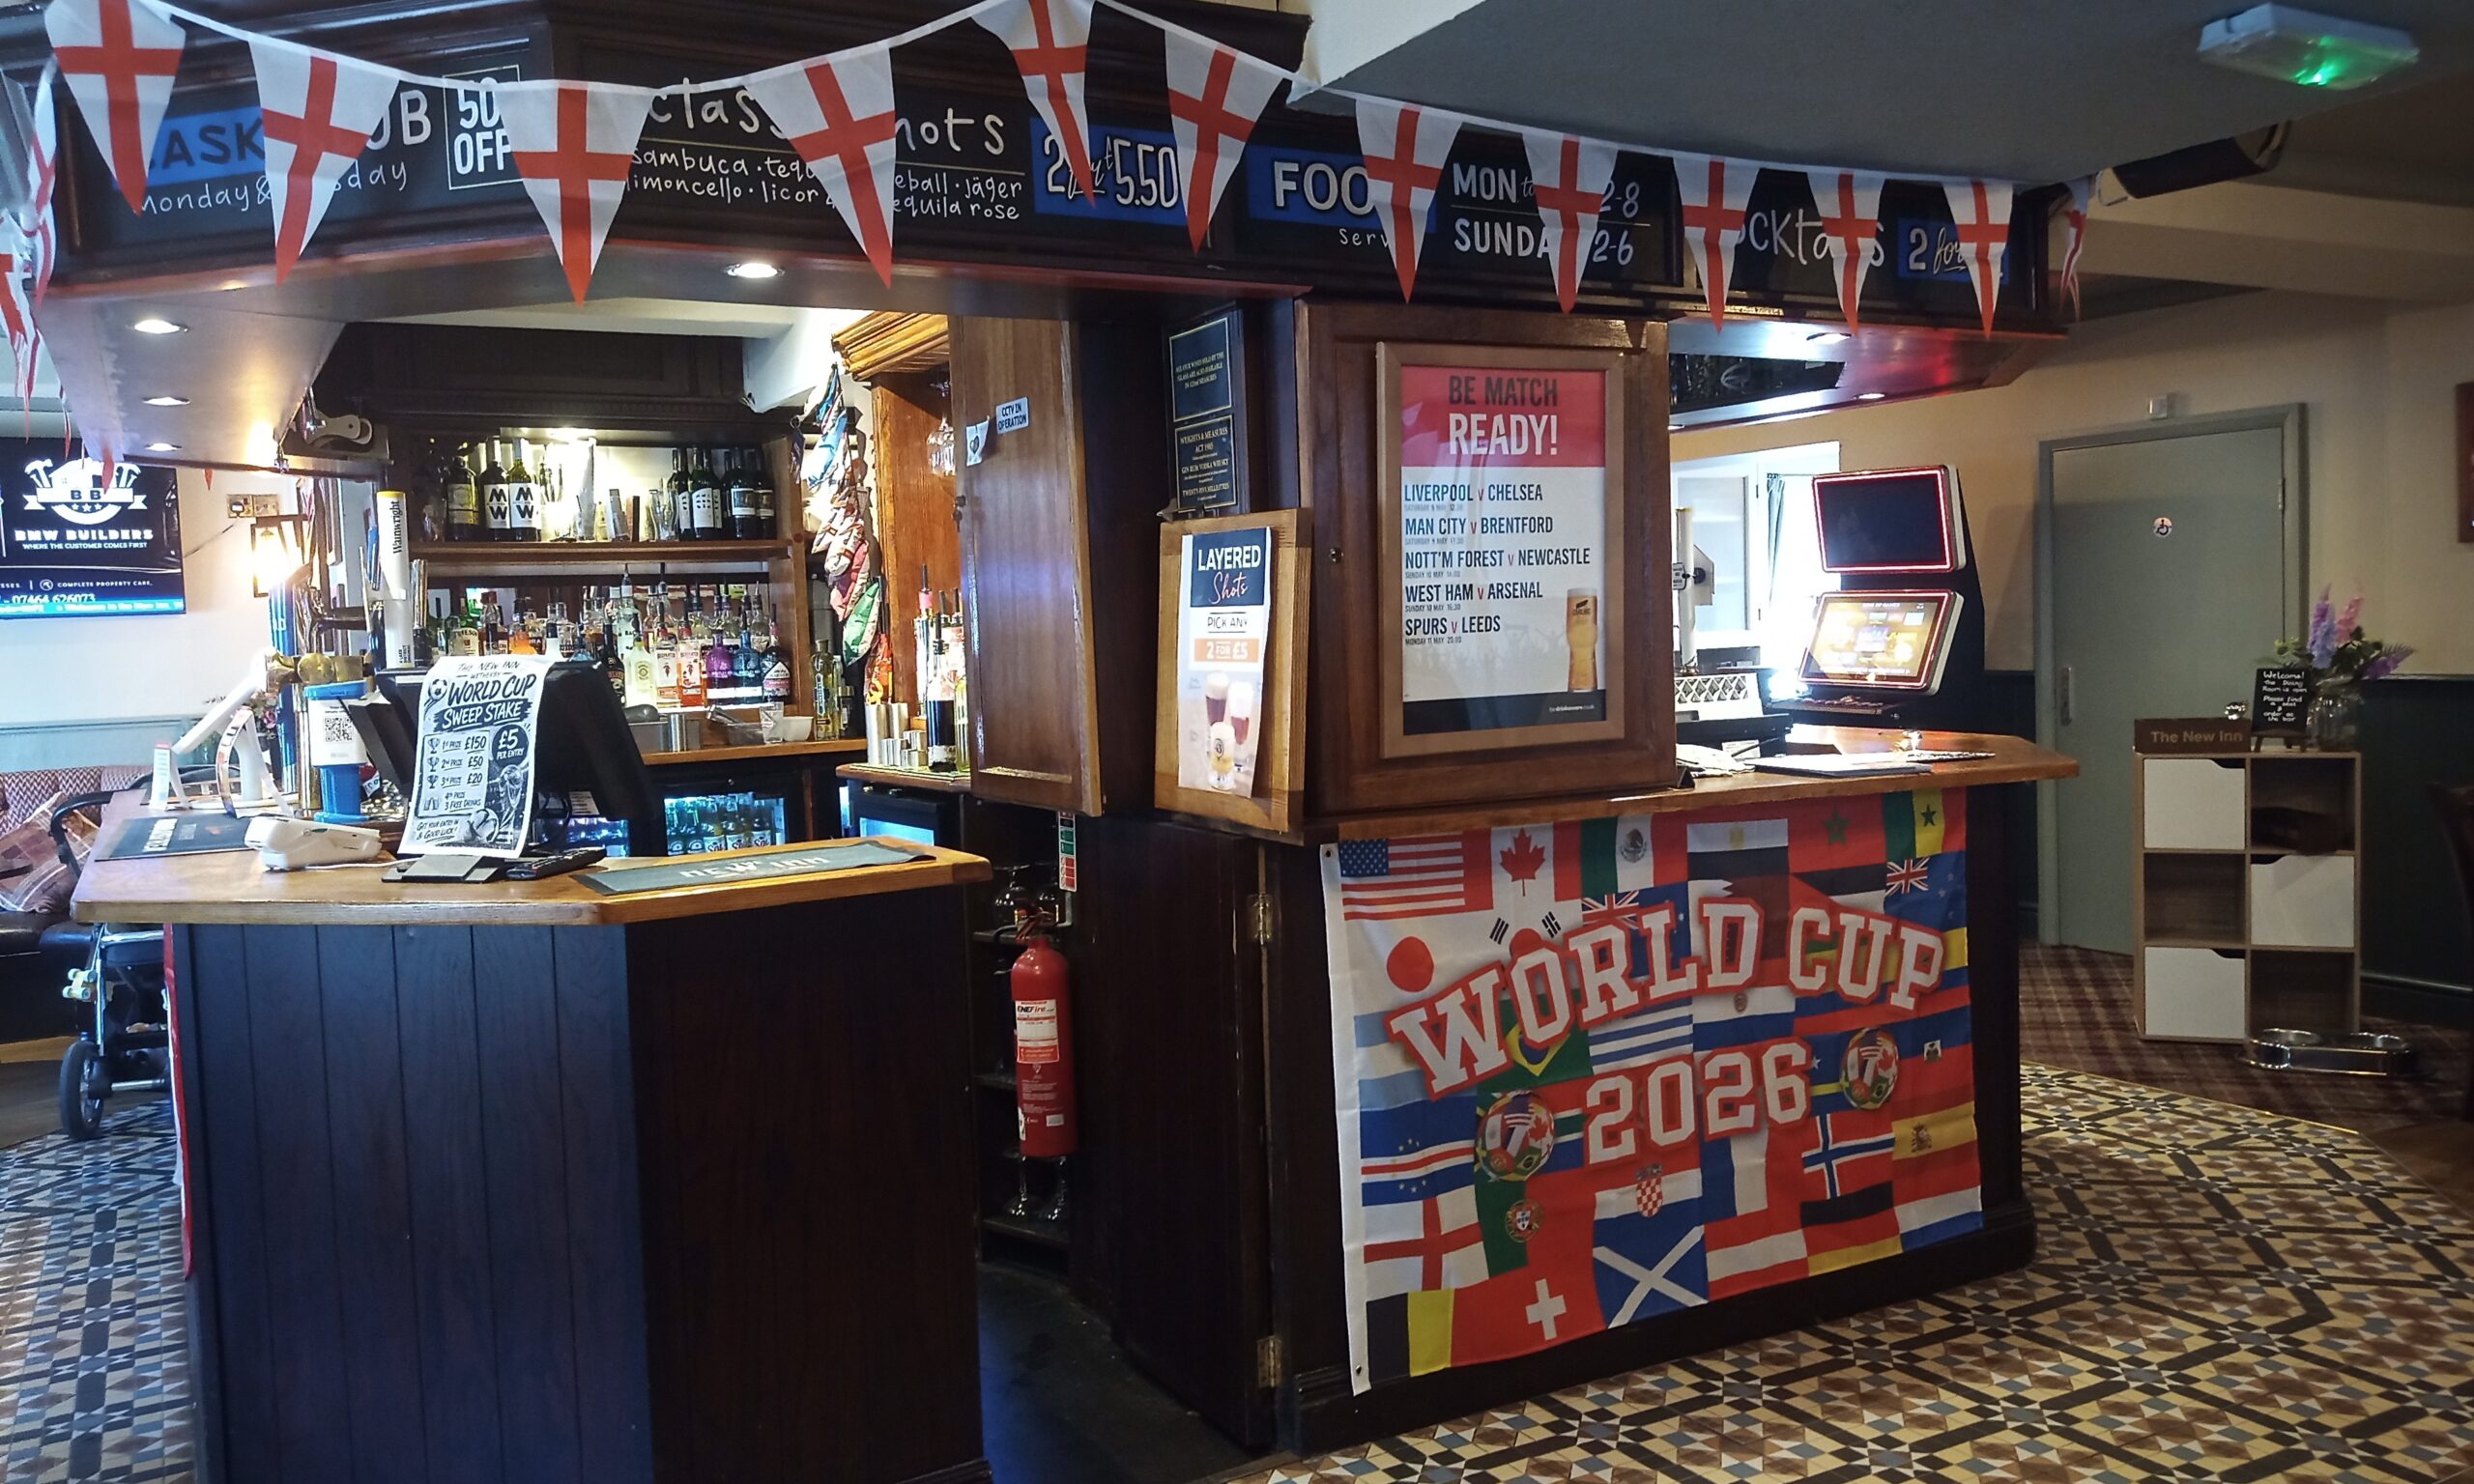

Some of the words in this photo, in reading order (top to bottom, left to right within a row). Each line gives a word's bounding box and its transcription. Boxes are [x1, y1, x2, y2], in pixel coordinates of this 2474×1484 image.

[149, 120, 266, 170] ASK
[453, 131, 511, 175] OFF
[631, 148, 749, 177] sambuca
[895, 169, 948, 196] eball
[627, 175, 742, 204] limoncello
[762, 181, 820, 203] licor
[893, 195, 962, 218] equila
[969, 202, 1021, 220] rose
[1273, 160, 1376, 215] FOO
[1339, 227, 1390, 247] Serv
[1453, 217, 1550, 259] SUNDA
[1910, 227, 1928, 271] 2
[1450, 375, 1476, 406] BE
[1484, 377, 1559, 407] MATCH
[998, 414, 1027, 431] OPERATION
[1001, 406, 1015, 417] CCTV
[1449, 413, 1559, 456] READY!
[1404, 484, 1474, 501] LIVERPOOL
[1488, 484, 1543, 500] CHELSEA
[389, 500, 403, 554] Wainwright
[1405, 518, 1434, 535] MAN
[1438, 517, 1467, 535] CITY
[1481, 516, 1554, 534] BRENTFORD
[1196, 544, 1262, 572] LAYERED
[1457, 550, 1505, 568] FOREST
[1518, 548, 1592, 566] NEWCASTLE
[1209, 571, 1249, 605] Shots
[1405, 584, 1442, 603] WEST
[1445, 583, 1474, 601] HAM
[1487, 582, 1543, 600] ARSENAL
[1207, 616, 1227, 629] PICK
[1405, 616, 1448, 637] SPURS
[1461, 615, 1501, 634] LEEDS
[1206, 642, 1215, 660] 2
[1232, 642, 1249, 659] £5
[2262, 671, 2305, 680] Welcome!
[447, 679, 502, 706] WORLD
[502, 672, 537, 699] CUP
[442, 705, 483, 729] SWEEP
[484, 700, 524, 723] STAKE
[464, 735, 487, 751] £150
[498, 728, 519, 750] £5
[2150, 731, 2178, 743] The
[2182, 730, 2216, 743] New
[2220, 730, 2243, 742] Inn
[468, 756, 483, 768] £50
[466, 772, 483, 785] £20
[1389, 900, 1764, 1096] WORLD
[1788, 905, 1945, 1012] CUP
[1584, 1039, 1810, 1165] 2026
